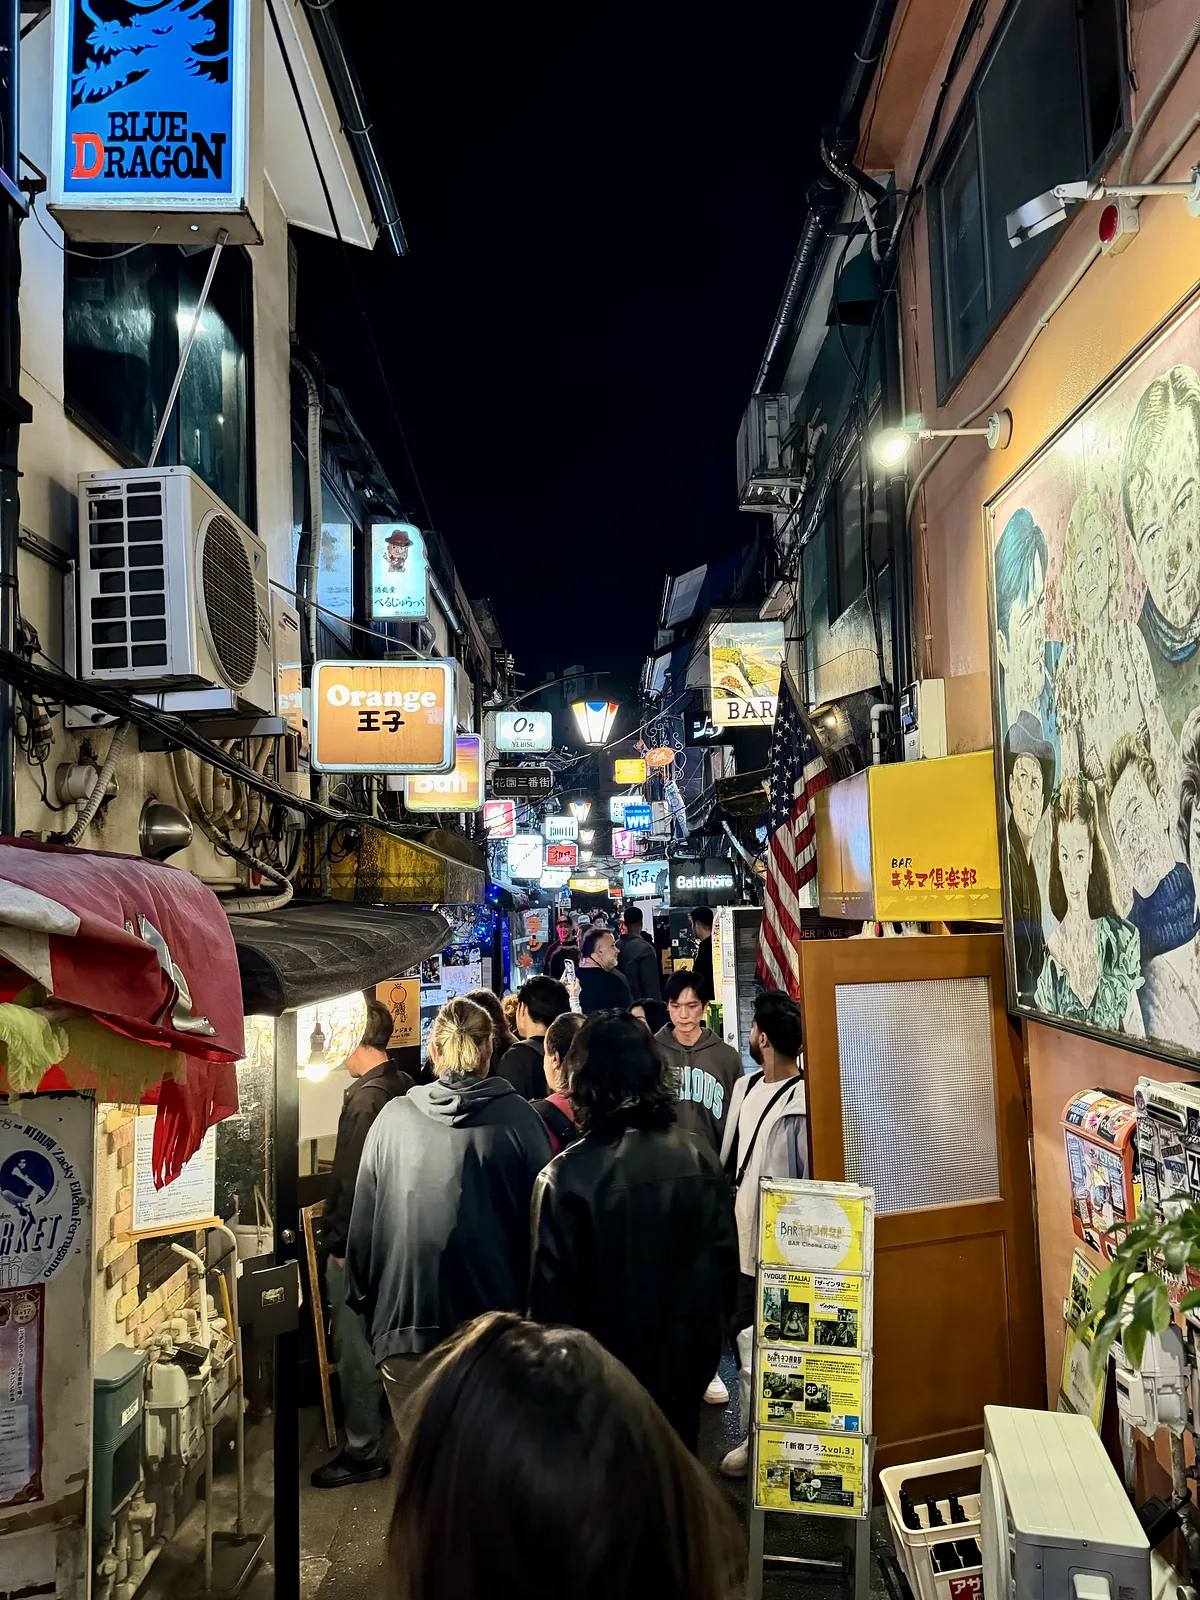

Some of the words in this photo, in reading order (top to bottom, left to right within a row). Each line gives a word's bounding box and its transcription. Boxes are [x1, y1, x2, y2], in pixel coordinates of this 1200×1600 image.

[107, 111, 187, 142] BLUE
[71, 132, 226, 179] DRAGON
[326, 684, 437, 712] Orange
[357, 710, 405, 733] 王子
[727, 701, 775, 720] BAR
[495, 776, 550, 788] 花園三番街
[891, 858, 913, 868] BAR
[676, 875, 734, 889] Baltimore
[891, 867, 978, 890] キネマ倶楽部
[52, 1147, 75, 1180] Zacky
[69, 1180, 83, 1217] Ellena
[806, 1385, 817, 1394] 2F
